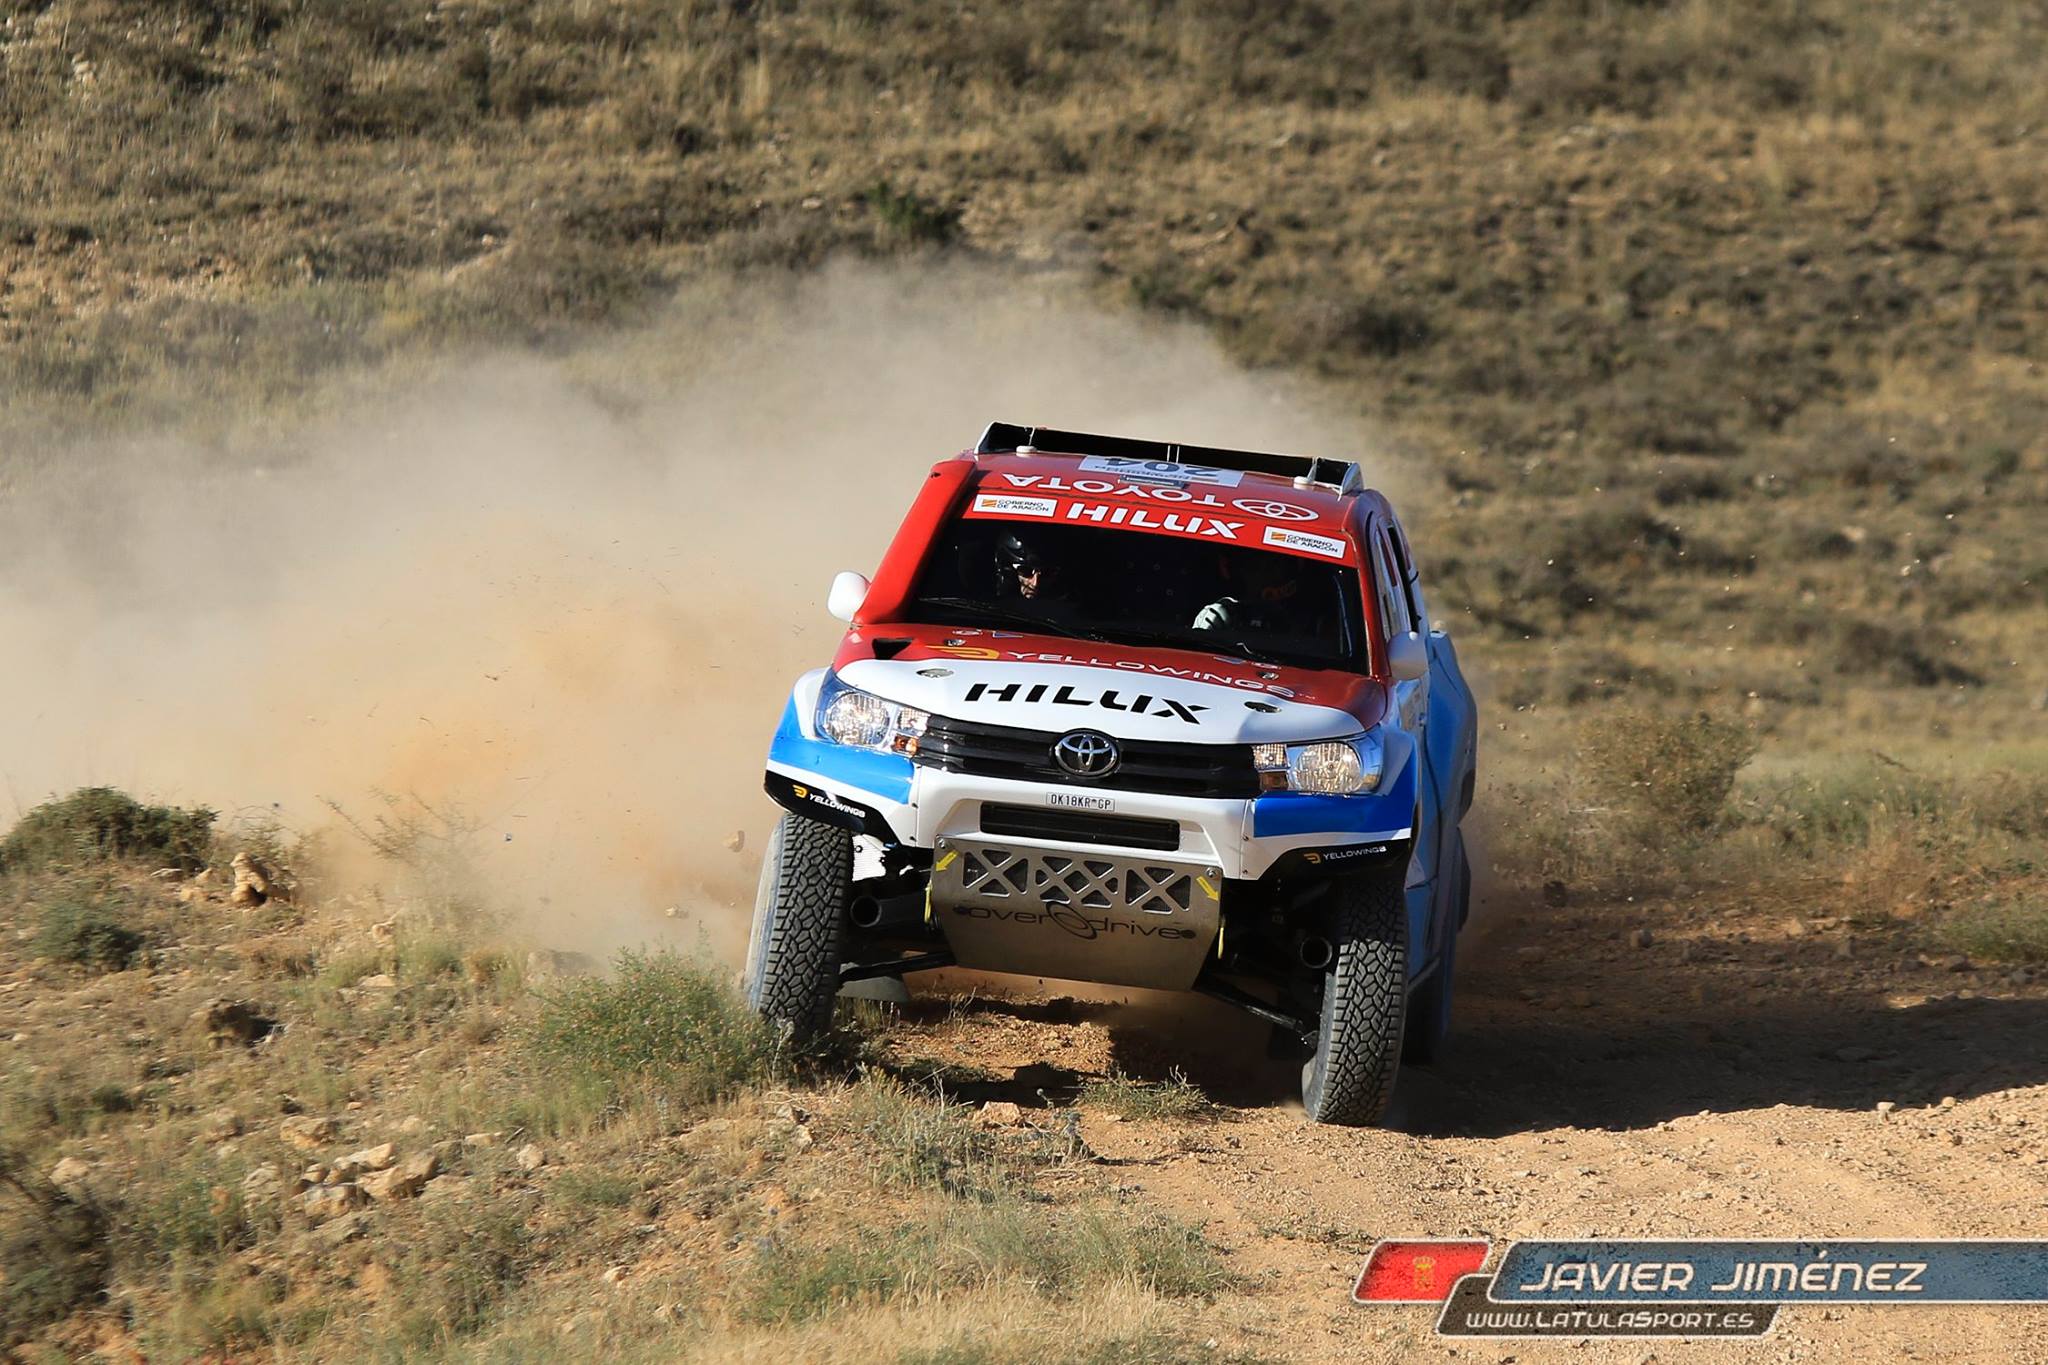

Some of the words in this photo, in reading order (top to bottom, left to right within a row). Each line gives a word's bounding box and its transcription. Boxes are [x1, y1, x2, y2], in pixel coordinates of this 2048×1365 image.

[1104, 457, 1221, 477] 204
[1001, 473, 1225, 507] TOYOTA
[998, 499, 1044, 507] GOBIERNO
[1065, 503, 1246, 540] HILUX
[1287, 534, 1333, 547] GOBIERNO
[1007, 650, 1297, 698] YELLOWINGS
[963, 682, 1211, 725] HILUX
[809, 793, 866, 818] YELLOWINGS
[1323, 845, 1387, 860] YELLOWINGS
